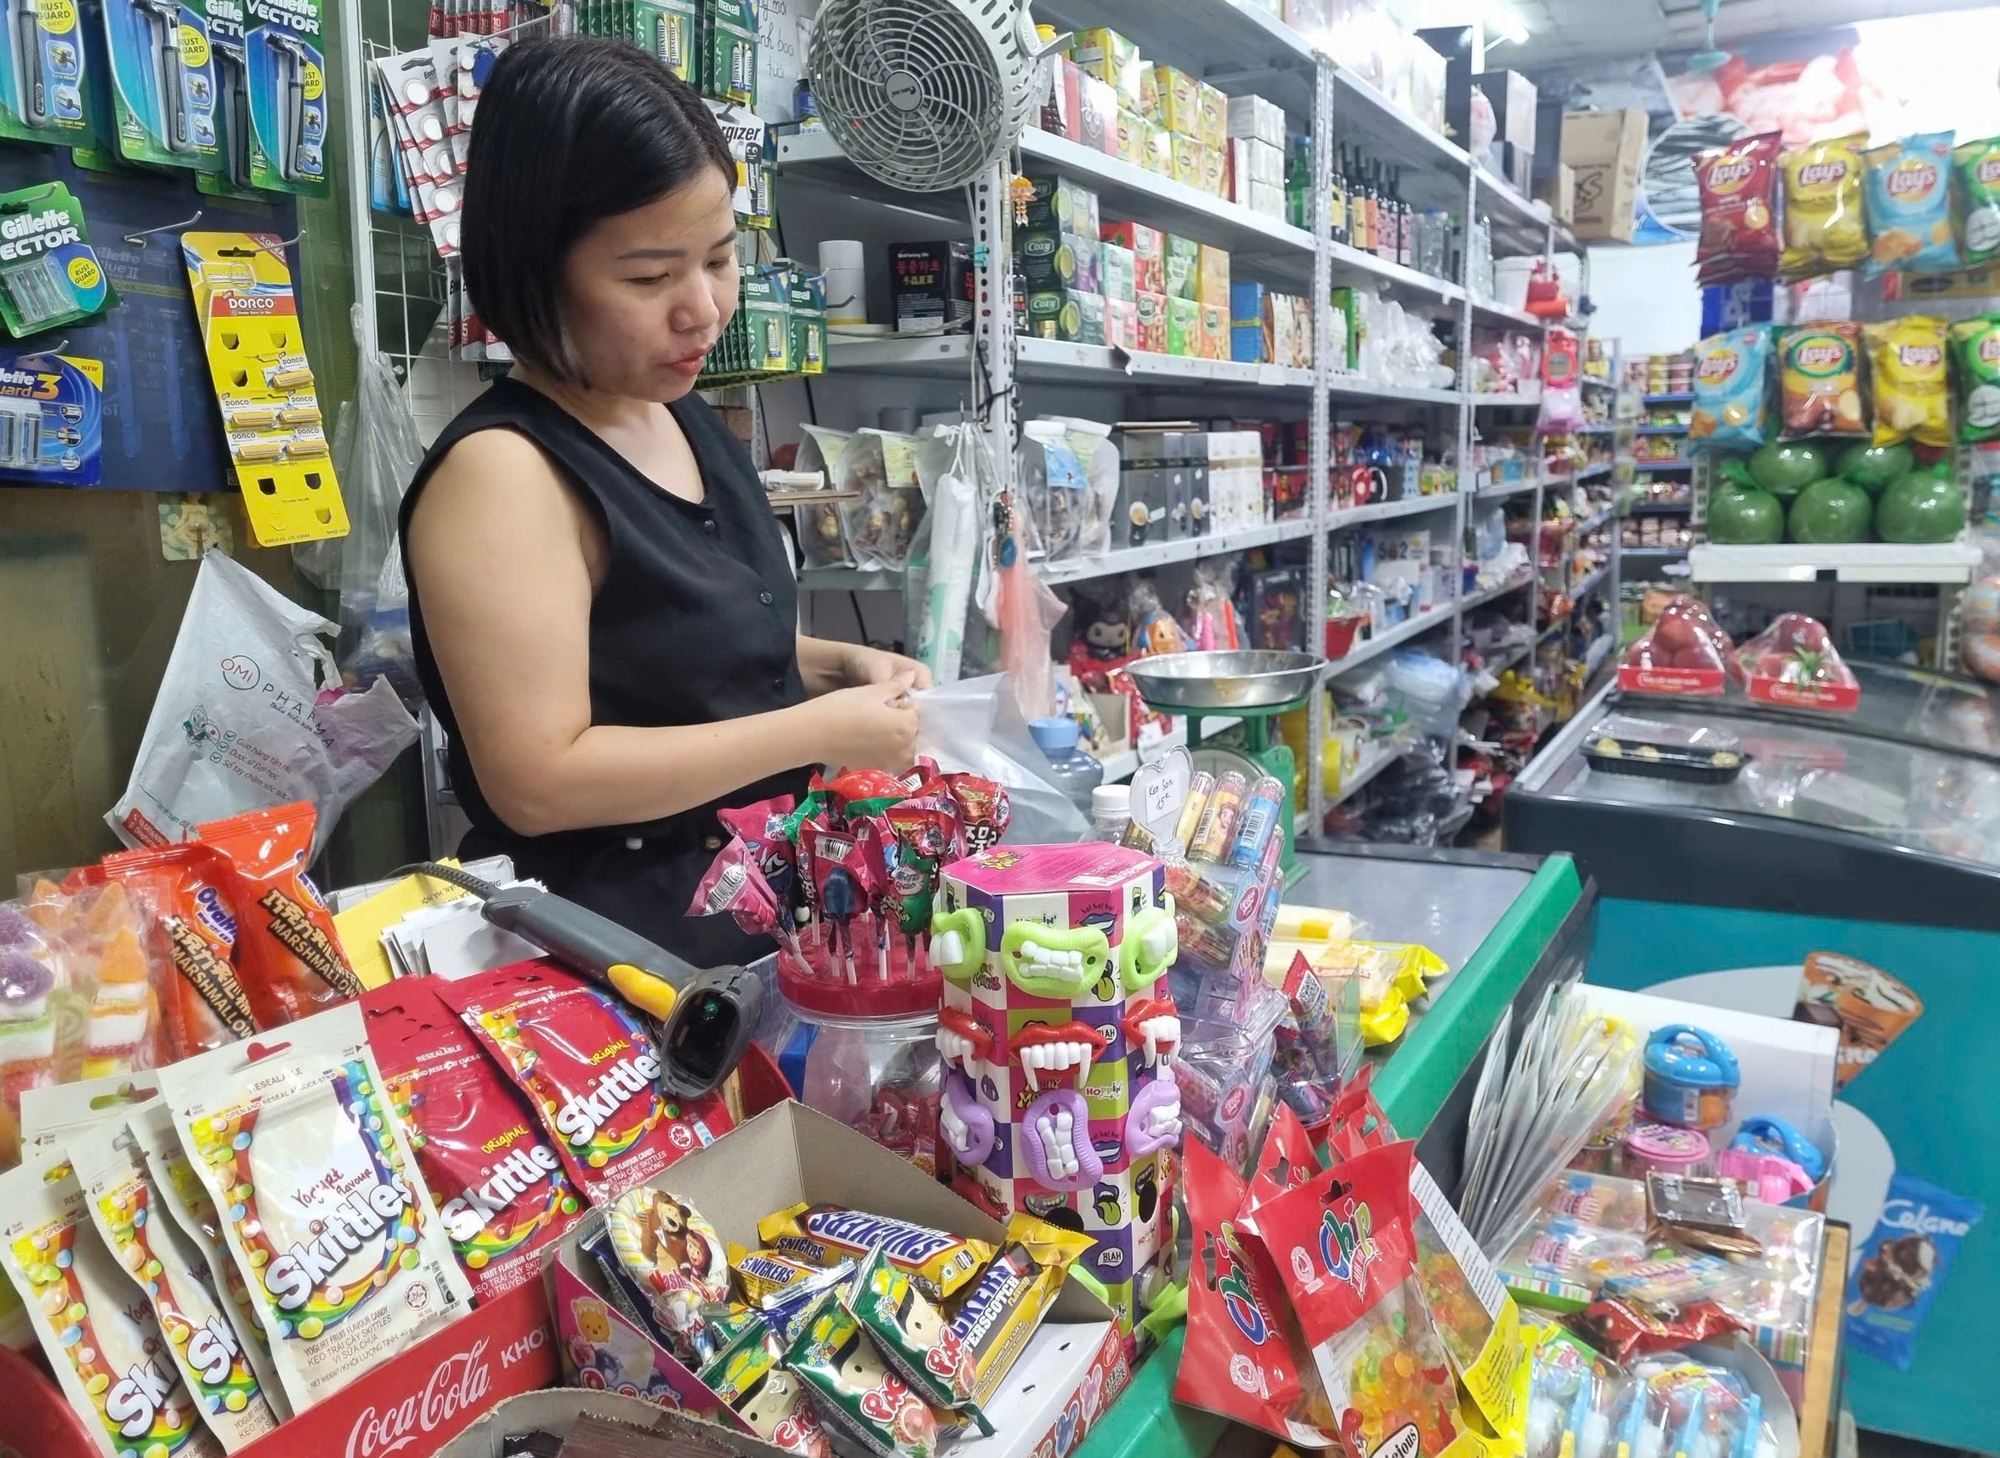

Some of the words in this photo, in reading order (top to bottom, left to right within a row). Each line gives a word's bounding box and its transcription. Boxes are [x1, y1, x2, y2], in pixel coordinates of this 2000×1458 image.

[1708, 161, 1752, 186] Lay's
[1800, 160, 1847, 187] Lay's
[1, 209, 70, 240] Gillette
[0, 226, 81, 261] ECTOR
[1028, 242, 1051, 252] Cozy
[228, 297, 275, 309] DORCO
[1034, 299, 1056, 308] Cozy
[282, 357, 304, 365] DORCO
[32, 373, 62, 400] 3
[232, 432, 257, 440] DORCO
[297, 427, 320, 436] DORCO
[221, 658, 254, 683] OMI
[271, 918, 358, 998] MARSHMALLOW
[169, 945, 255, 1039] MARSHMALLOW
[415, 1043, 463, 1063] RESEALABLE
[225, 1108, 247, 1121] OPEN
[262, 1091, 289, 1106] RESEAL
[602, 1166, 619, 1178] FRUIT
[617, 1156, 639, 1171] FLAVOUR
[637, 1147, 656, 1161] CANDY
[640, 1150, 668, 1168] SKITTLES
[44, 1222, 62, 1238] OPEN
[264, 1173, 413, 1310] Skittles
[809, 1212, 950, 1260] SNICKERS
[776, 1237, 825, 1262] SNICKERS
[1103, 1249, 1122, 1261] BLAH
[480, 1267, 498, 1282] FRUIT
[497, 1256, 526, 1273] FLAVOUR
[737, 1257, 797, 1284] SNICKERS
[1008, 1276, 1031, 1307] FLAVOUR
[303, 1339, 330, 1357] YOGURT
[329, 1331, 347, 1346] FRUIT
[345, 1317, 371, 1337] FLAVOUR
[370, 1305, 389, 1322] CANDY
[361, 1315, 393, 1339] SKITTLES
[310, 1379, 321, 1389] NET
[345, 1336, 491, 1458] Coca-Cola
